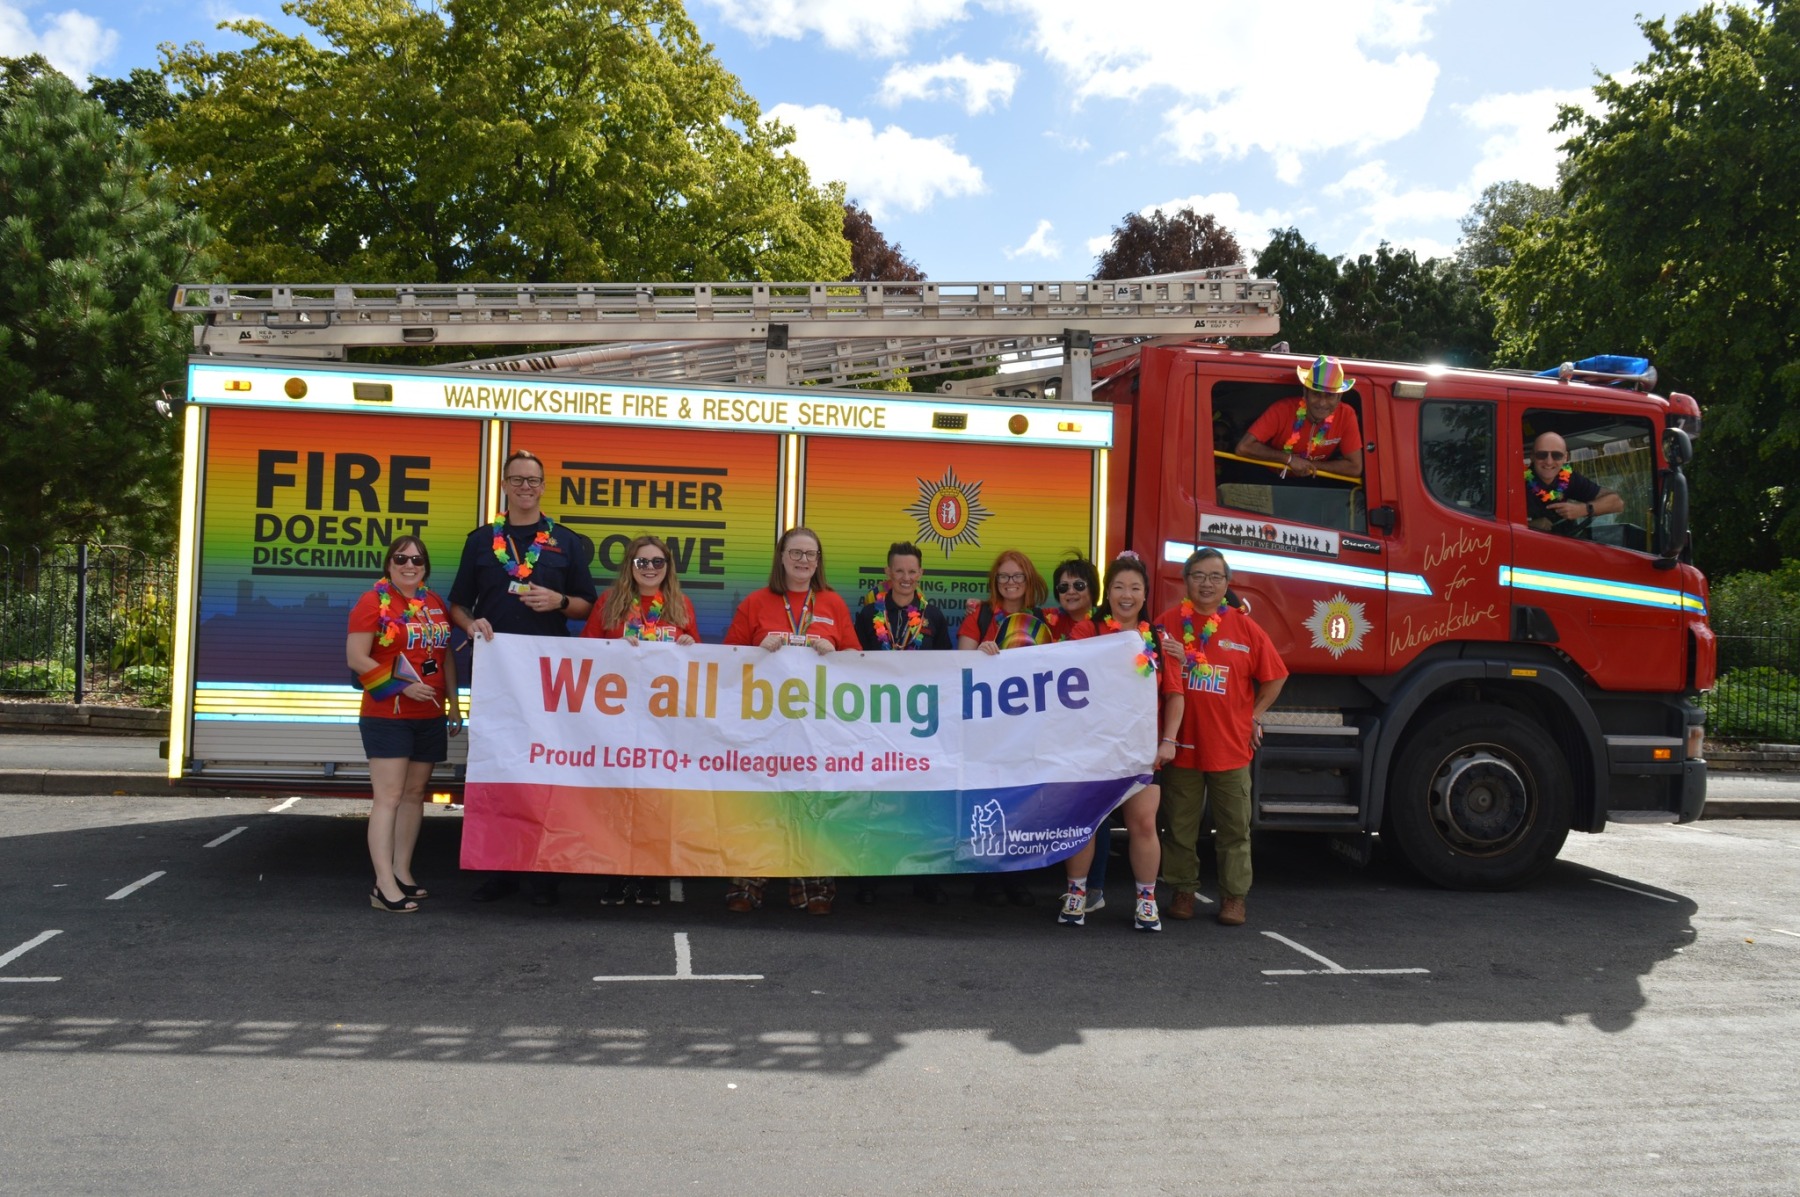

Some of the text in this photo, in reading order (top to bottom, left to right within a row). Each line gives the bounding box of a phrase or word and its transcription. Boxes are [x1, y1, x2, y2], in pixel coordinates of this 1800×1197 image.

[444, 385, 886, 429] WARWICKSHIRE FIRE & RESCUE SERVICE
[256, 449, 431, 514] FIRE
[560, 476, 723, 511] NEITHER
[254, 513, 428, 547] DOESN'T
[1240, 539, 1256, 547] LEST
[1271, 542, 1298, 552] FORGET
[253, 547, 381, 568] DISCRIMIN
[1424, 527, 1492, 571] Working
[1445, 565, 1475, 601] for
[1390, 601, 1500, 656] Warwickshire
[539, 657, 1090, 738] We all belong here
[529, 742, 930, 777] Proud LGBTQ+ colleagues and allies
[1008, 826, 1092, 842] Warwickshire
[1008, 842, 1048, 855] County
